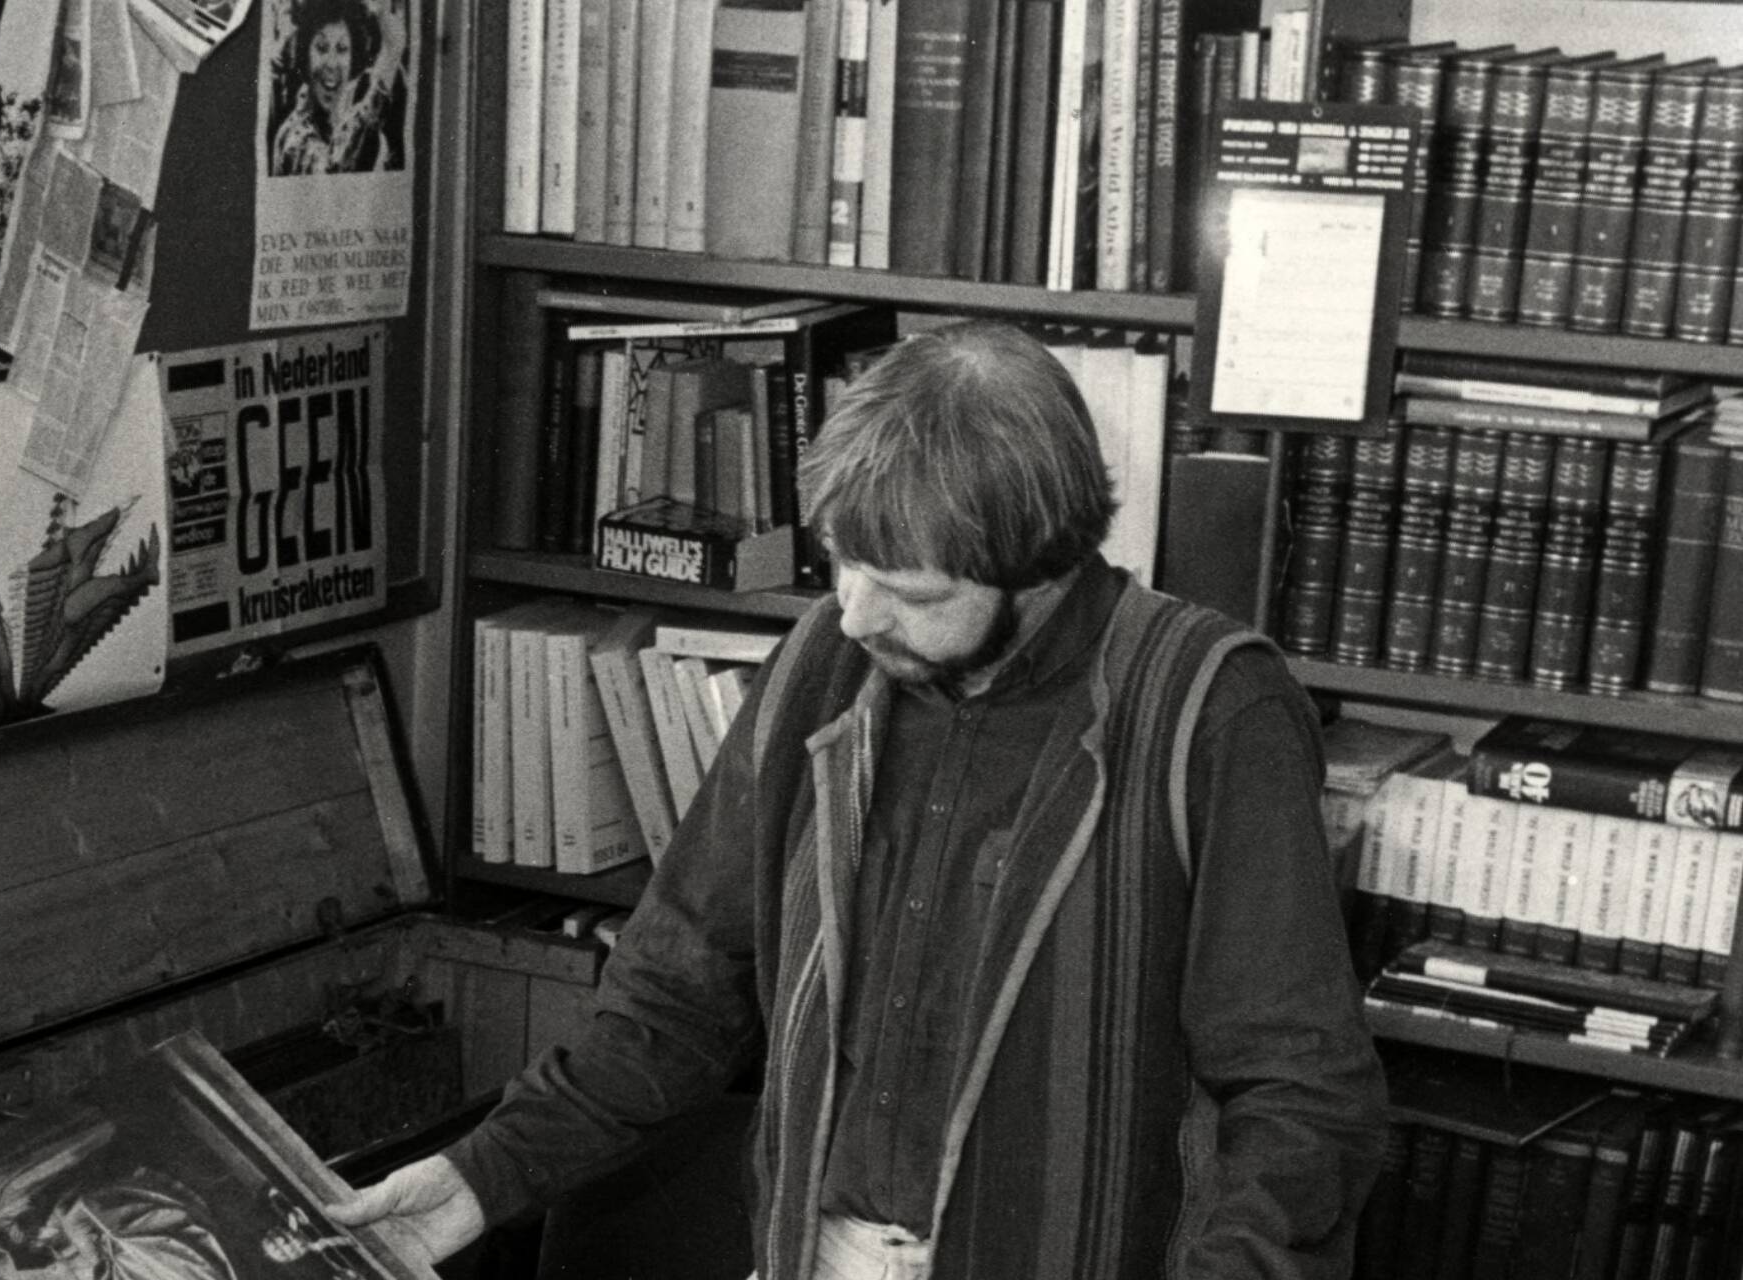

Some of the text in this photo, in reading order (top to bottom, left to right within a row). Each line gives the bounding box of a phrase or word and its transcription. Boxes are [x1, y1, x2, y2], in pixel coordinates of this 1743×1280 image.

[1108, 126, 1125, 194] World
[831, 199, 849, 225] 2
[260, 232, 298, 251] EVEN
[373, 227, 407, 245] NAAR
[259, 256, 282, 275] DIE
[258, 280, 272, 299] IK
[279, 278, 309, 298] RED
[382, 271, 407, 288] MET
[234, 336, 370, 400] in Nederland
[794, 373, 807, 393] De
[794, 394, 808, 434] Grote
[236, 385, 372, 576] GEEN
[602, 526, 704, 559] HALLIWELL'S
[601, 546, 702, 584] FILM GUIDE
[238, 566, 375, 628] kruisraketten
[1521, 761, 1552, 803] 40
